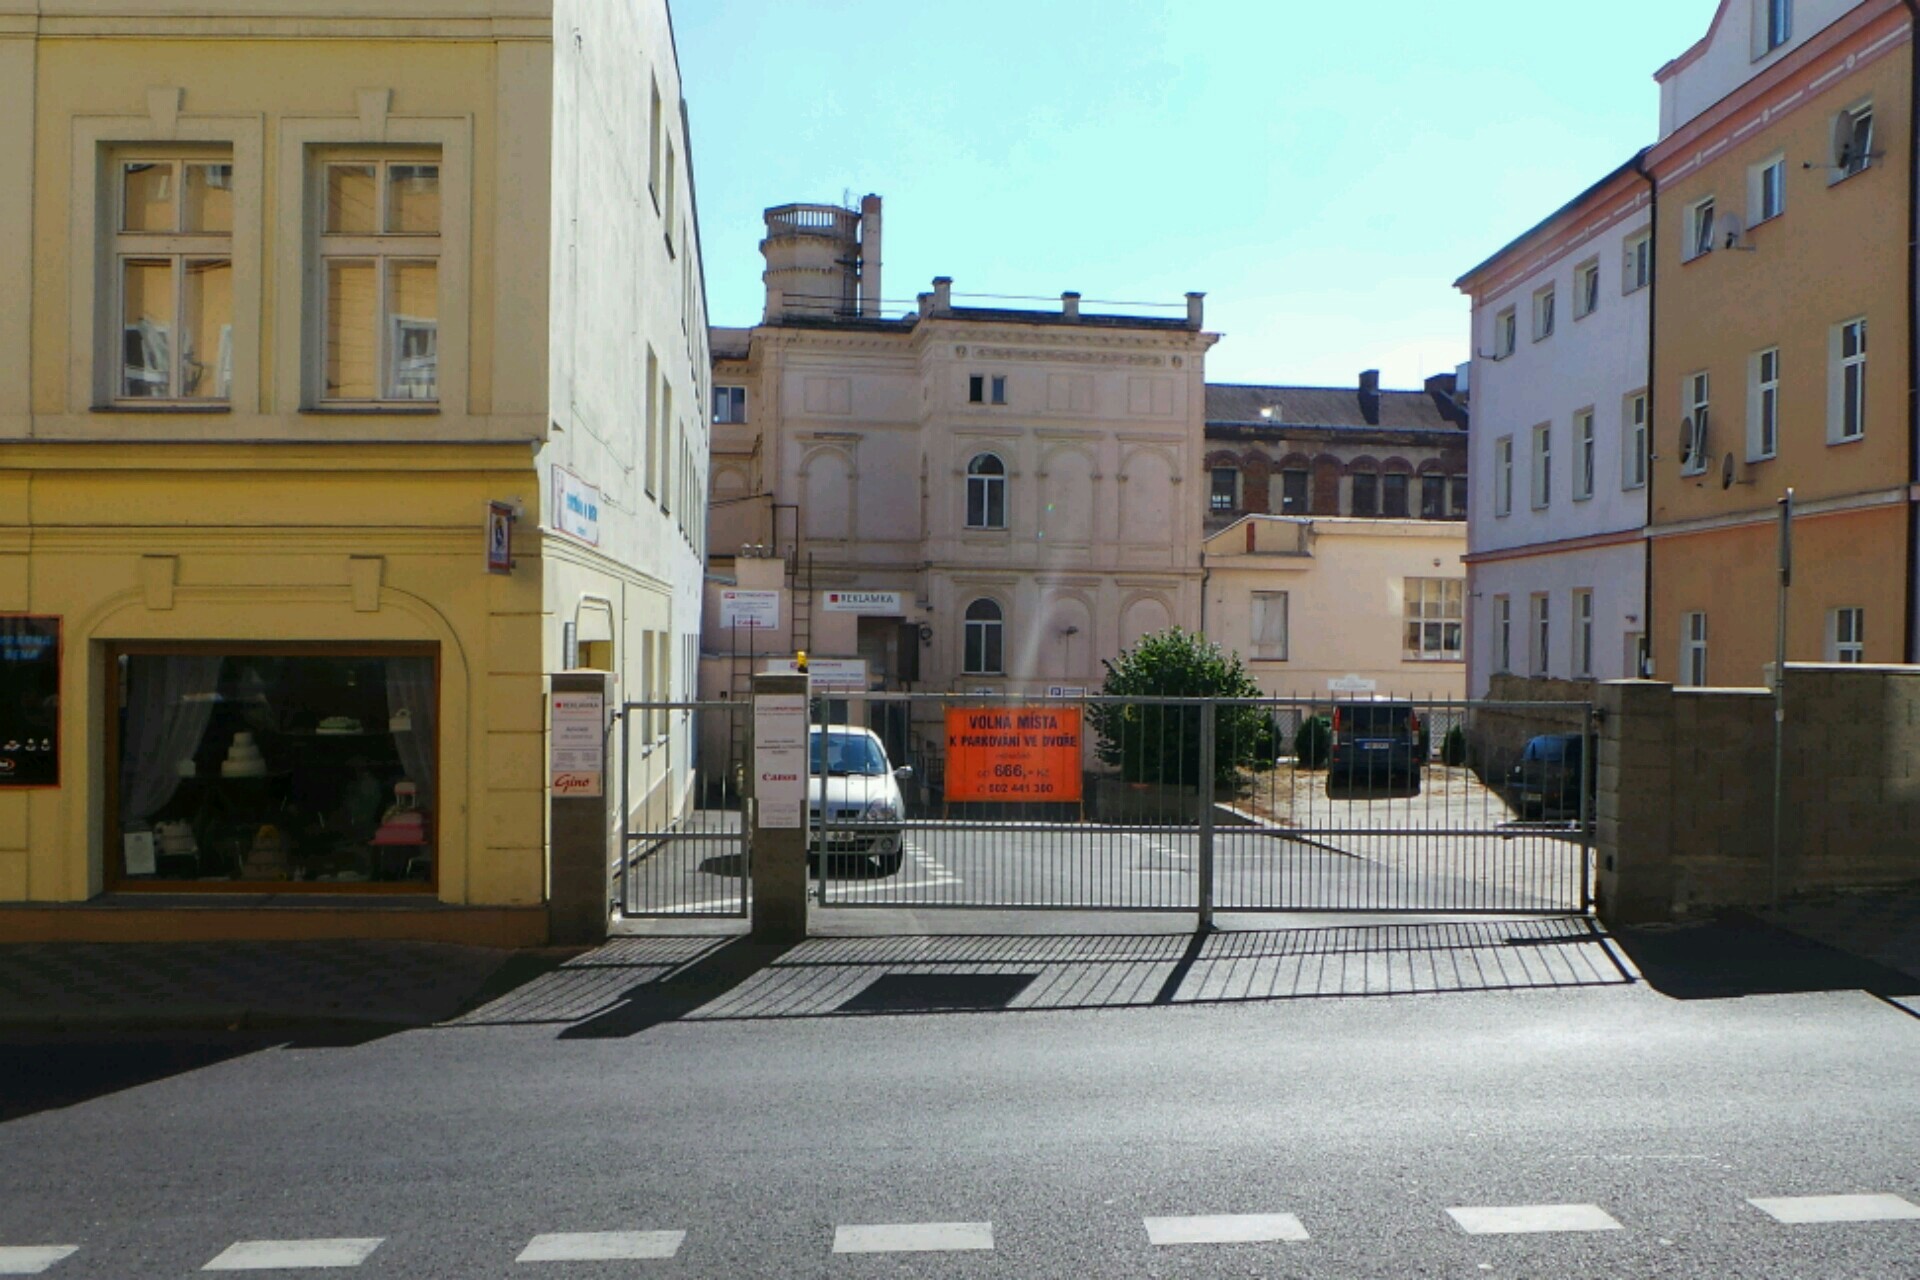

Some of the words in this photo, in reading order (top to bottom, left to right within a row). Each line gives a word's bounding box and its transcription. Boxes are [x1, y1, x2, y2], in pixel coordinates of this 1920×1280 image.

[841, 594, 894, 603] REKLAMKA
[969, 711, 1012, 729] VOLNÁ
[1017, 711, 1058, 729] MÍSTA
[949, 735, 957, 747] K
[961, 733, 1020, 747] PARKOVÁNÍ
[1024, 735, 1038, 747] VE
[1042, 733, 1077, 747] DVOŘE
